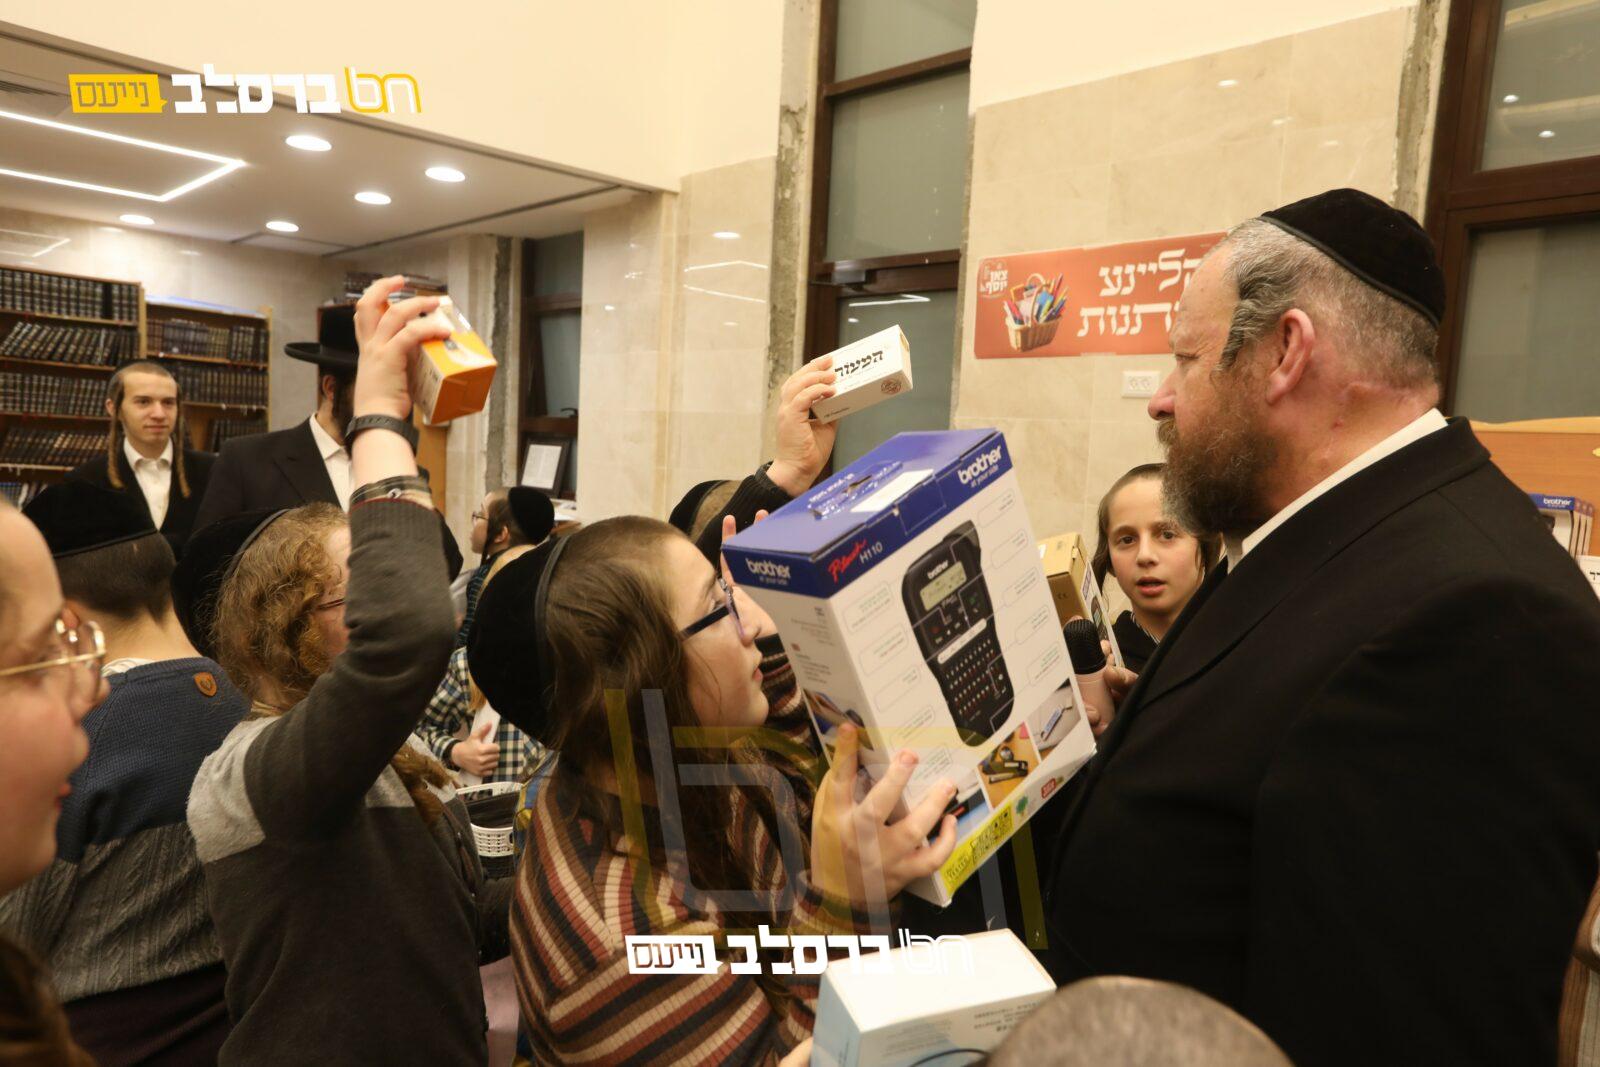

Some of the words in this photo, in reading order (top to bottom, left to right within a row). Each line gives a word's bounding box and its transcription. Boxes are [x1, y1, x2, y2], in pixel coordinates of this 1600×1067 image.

[1076, 300, 1180, 338] תנות
[957, 445, 1002, 485] brother
[1543, 497, 1572, 506] brother
[859, 541, 884, 565] H110
[745, 557, 792, 580] brother
